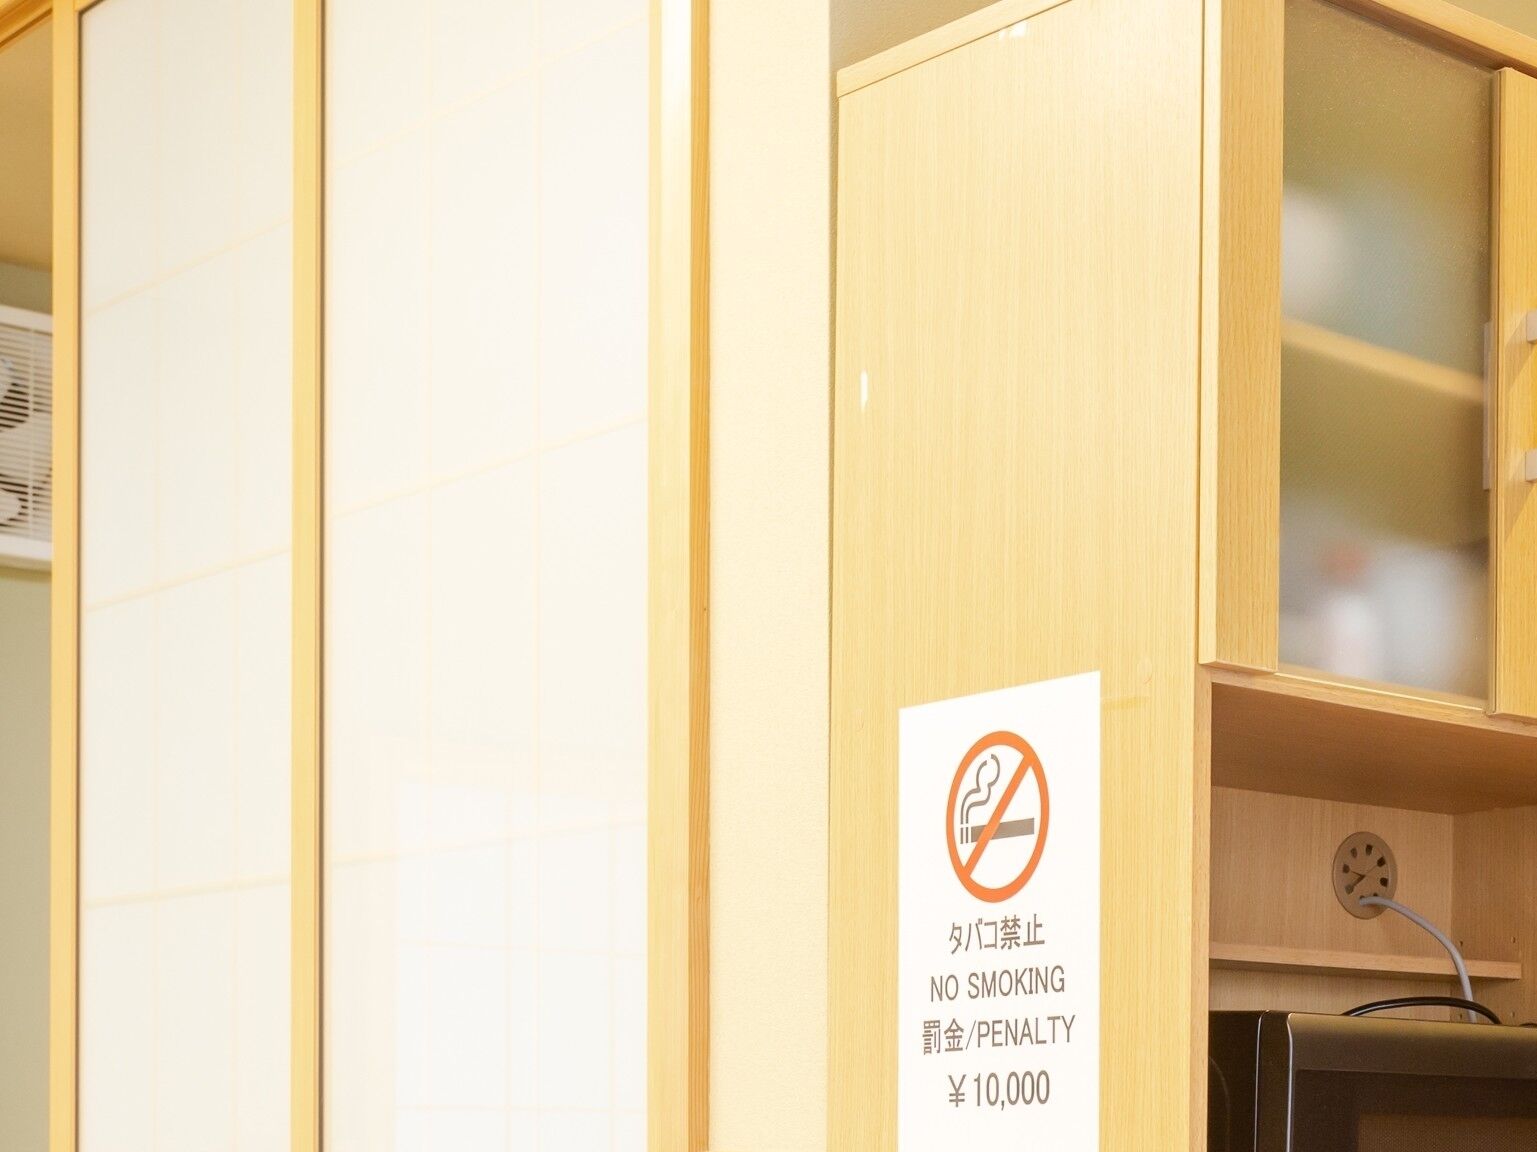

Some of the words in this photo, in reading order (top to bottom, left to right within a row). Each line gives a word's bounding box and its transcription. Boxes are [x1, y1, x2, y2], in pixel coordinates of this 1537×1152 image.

[948, 913, 1046, 955] タバコ禁止
[930, 975, 960, 1002] NO
[968, 965, 1066, 999] SMOKING
[922, 1014, 1076, 1055] 罰金/PENALTY
